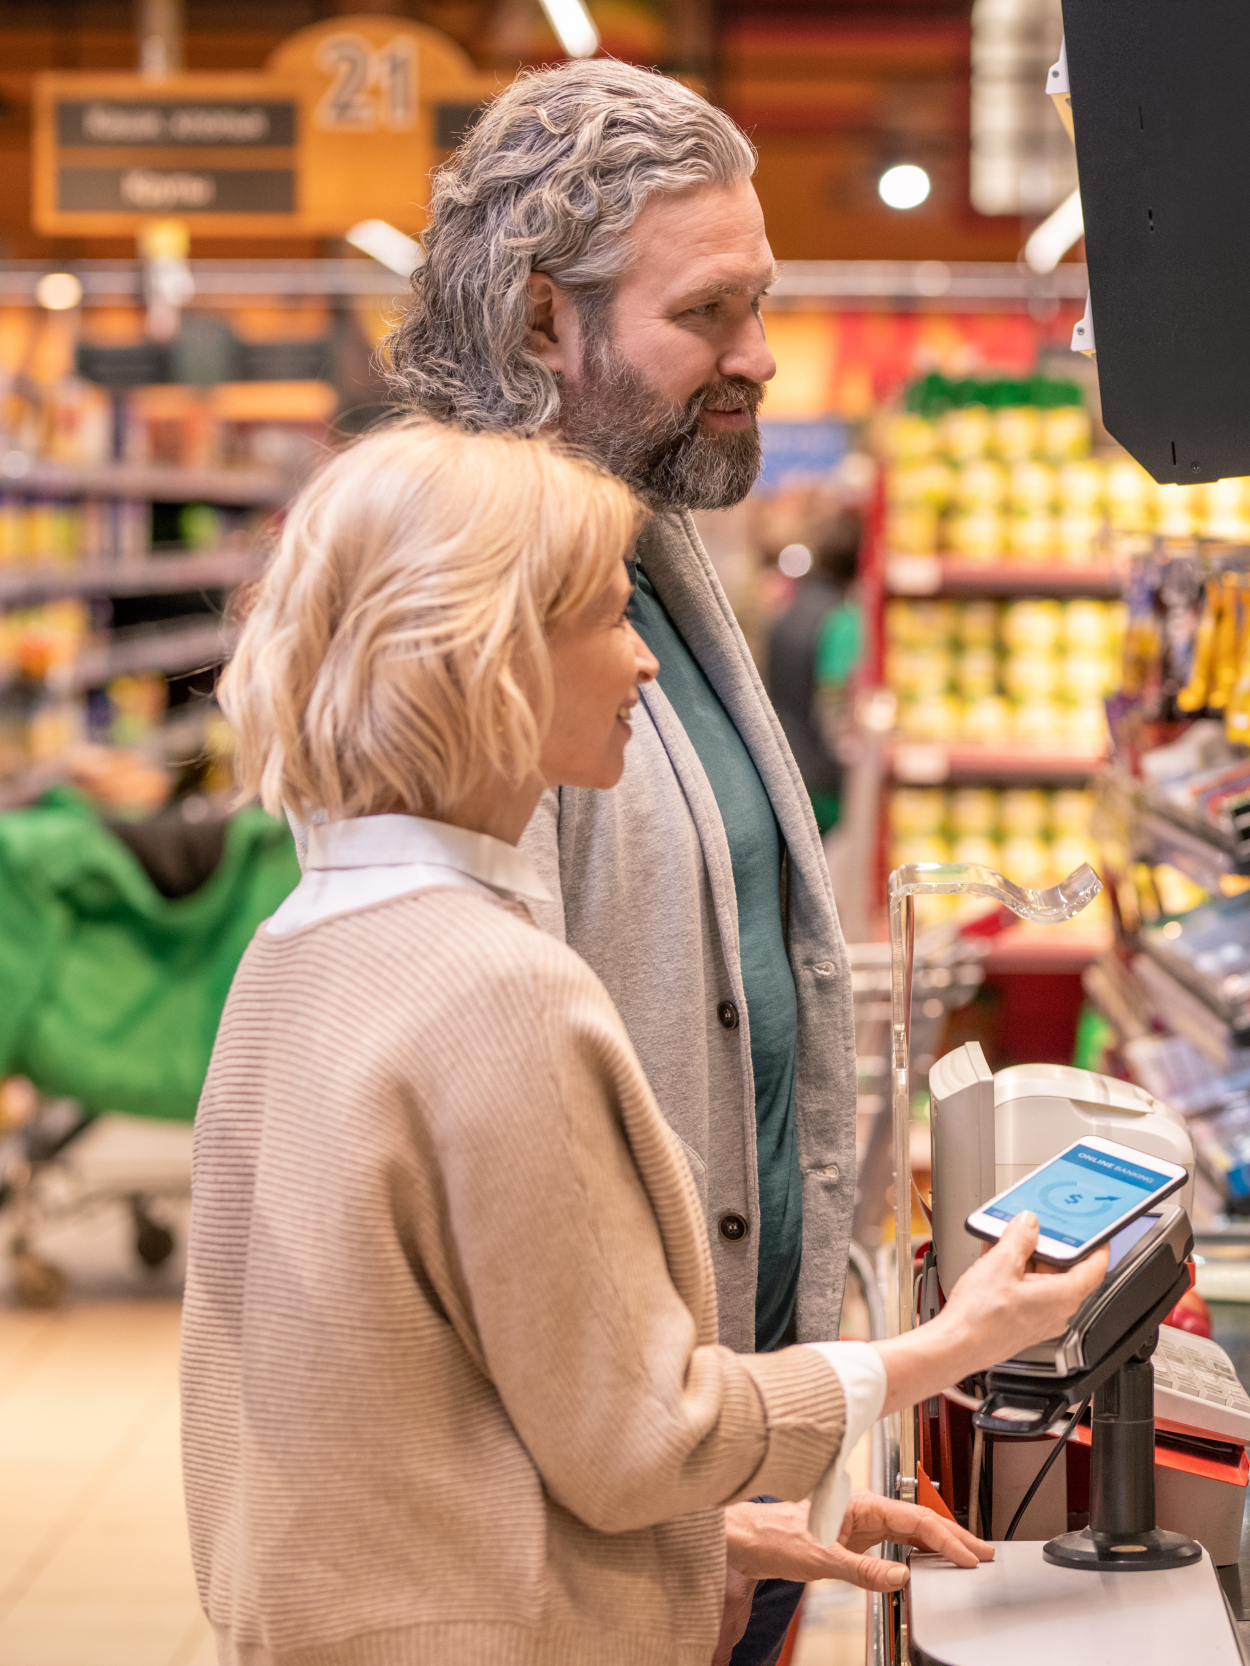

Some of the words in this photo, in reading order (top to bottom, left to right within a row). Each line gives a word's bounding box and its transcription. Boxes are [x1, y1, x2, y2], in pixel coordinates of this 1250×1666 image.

[316, 35, 417, 131] 21
[1078, 1152, 1115, 1169] ONLINE
[1114, 1165, 1155, 1184] BANKING
